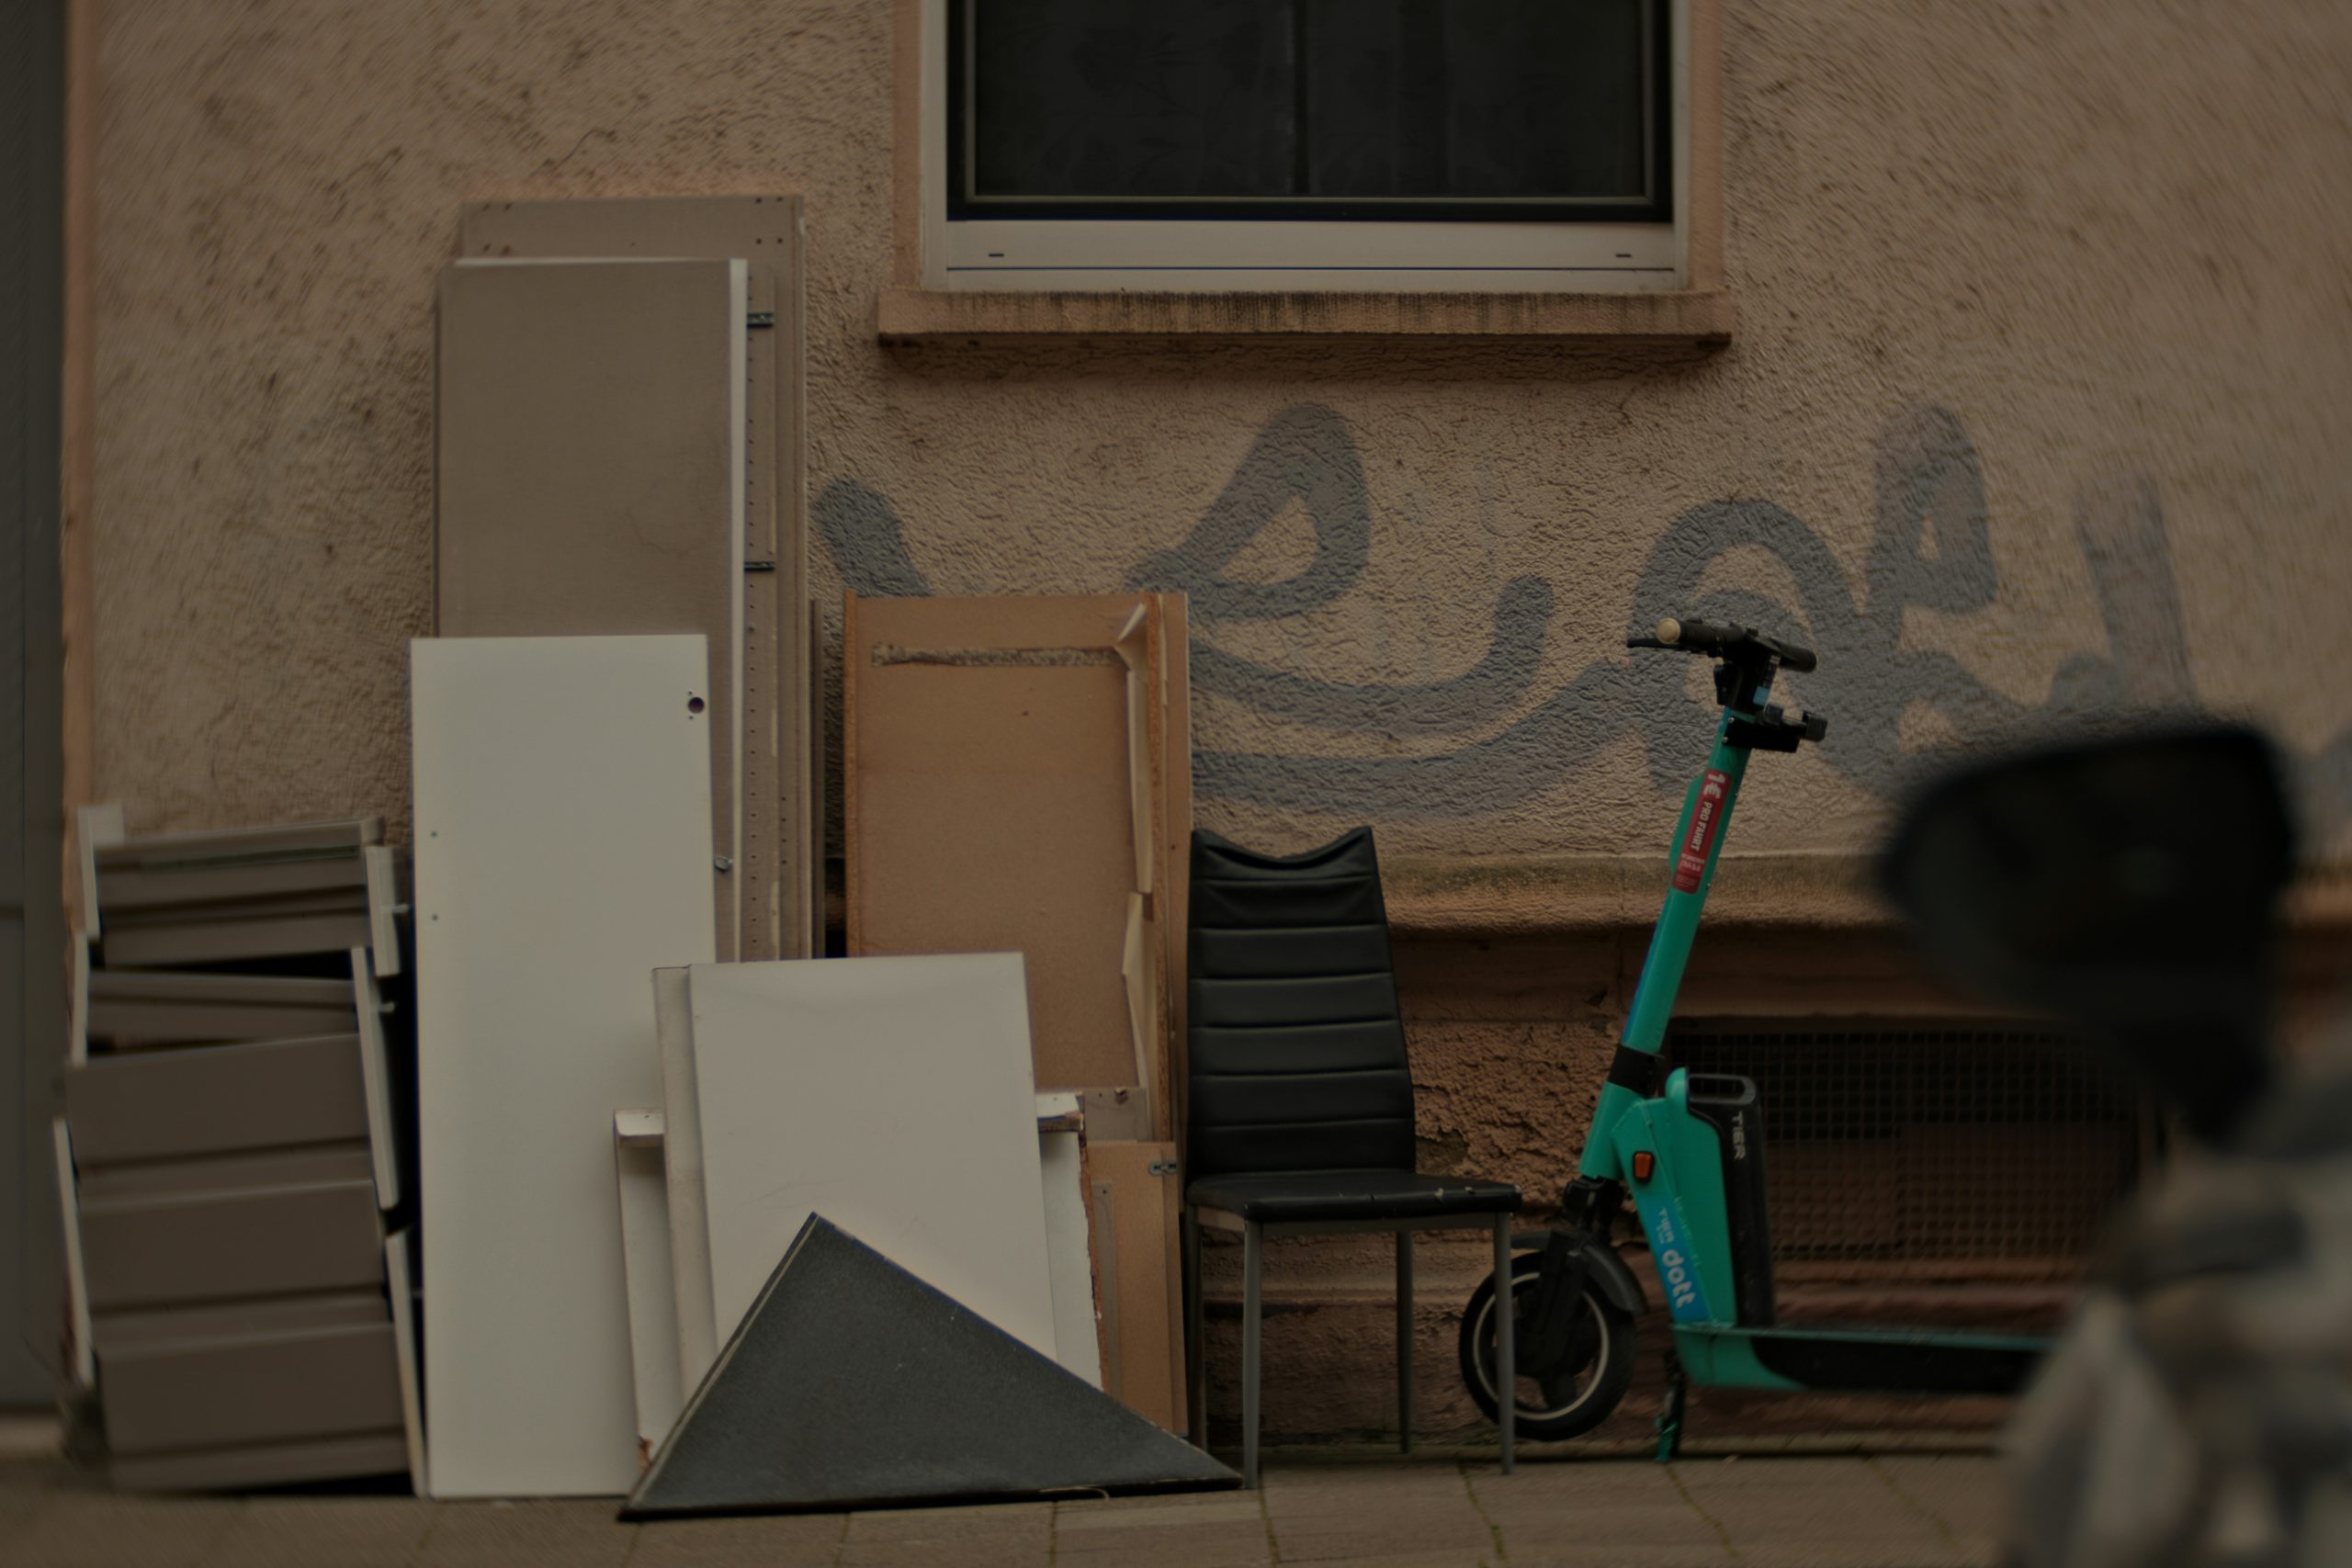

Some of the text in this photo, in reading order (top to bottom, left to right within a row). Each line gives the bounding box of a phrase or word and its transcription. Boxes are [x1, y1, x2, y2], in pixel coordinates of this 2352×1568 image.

[1700, 801, 1713, 821] PRO
[1690, 820, 1708, 852] FAHRT
[1731, 1109, 1746, 1161] TIER
[1661, 1248, 1697, 1309] dott
